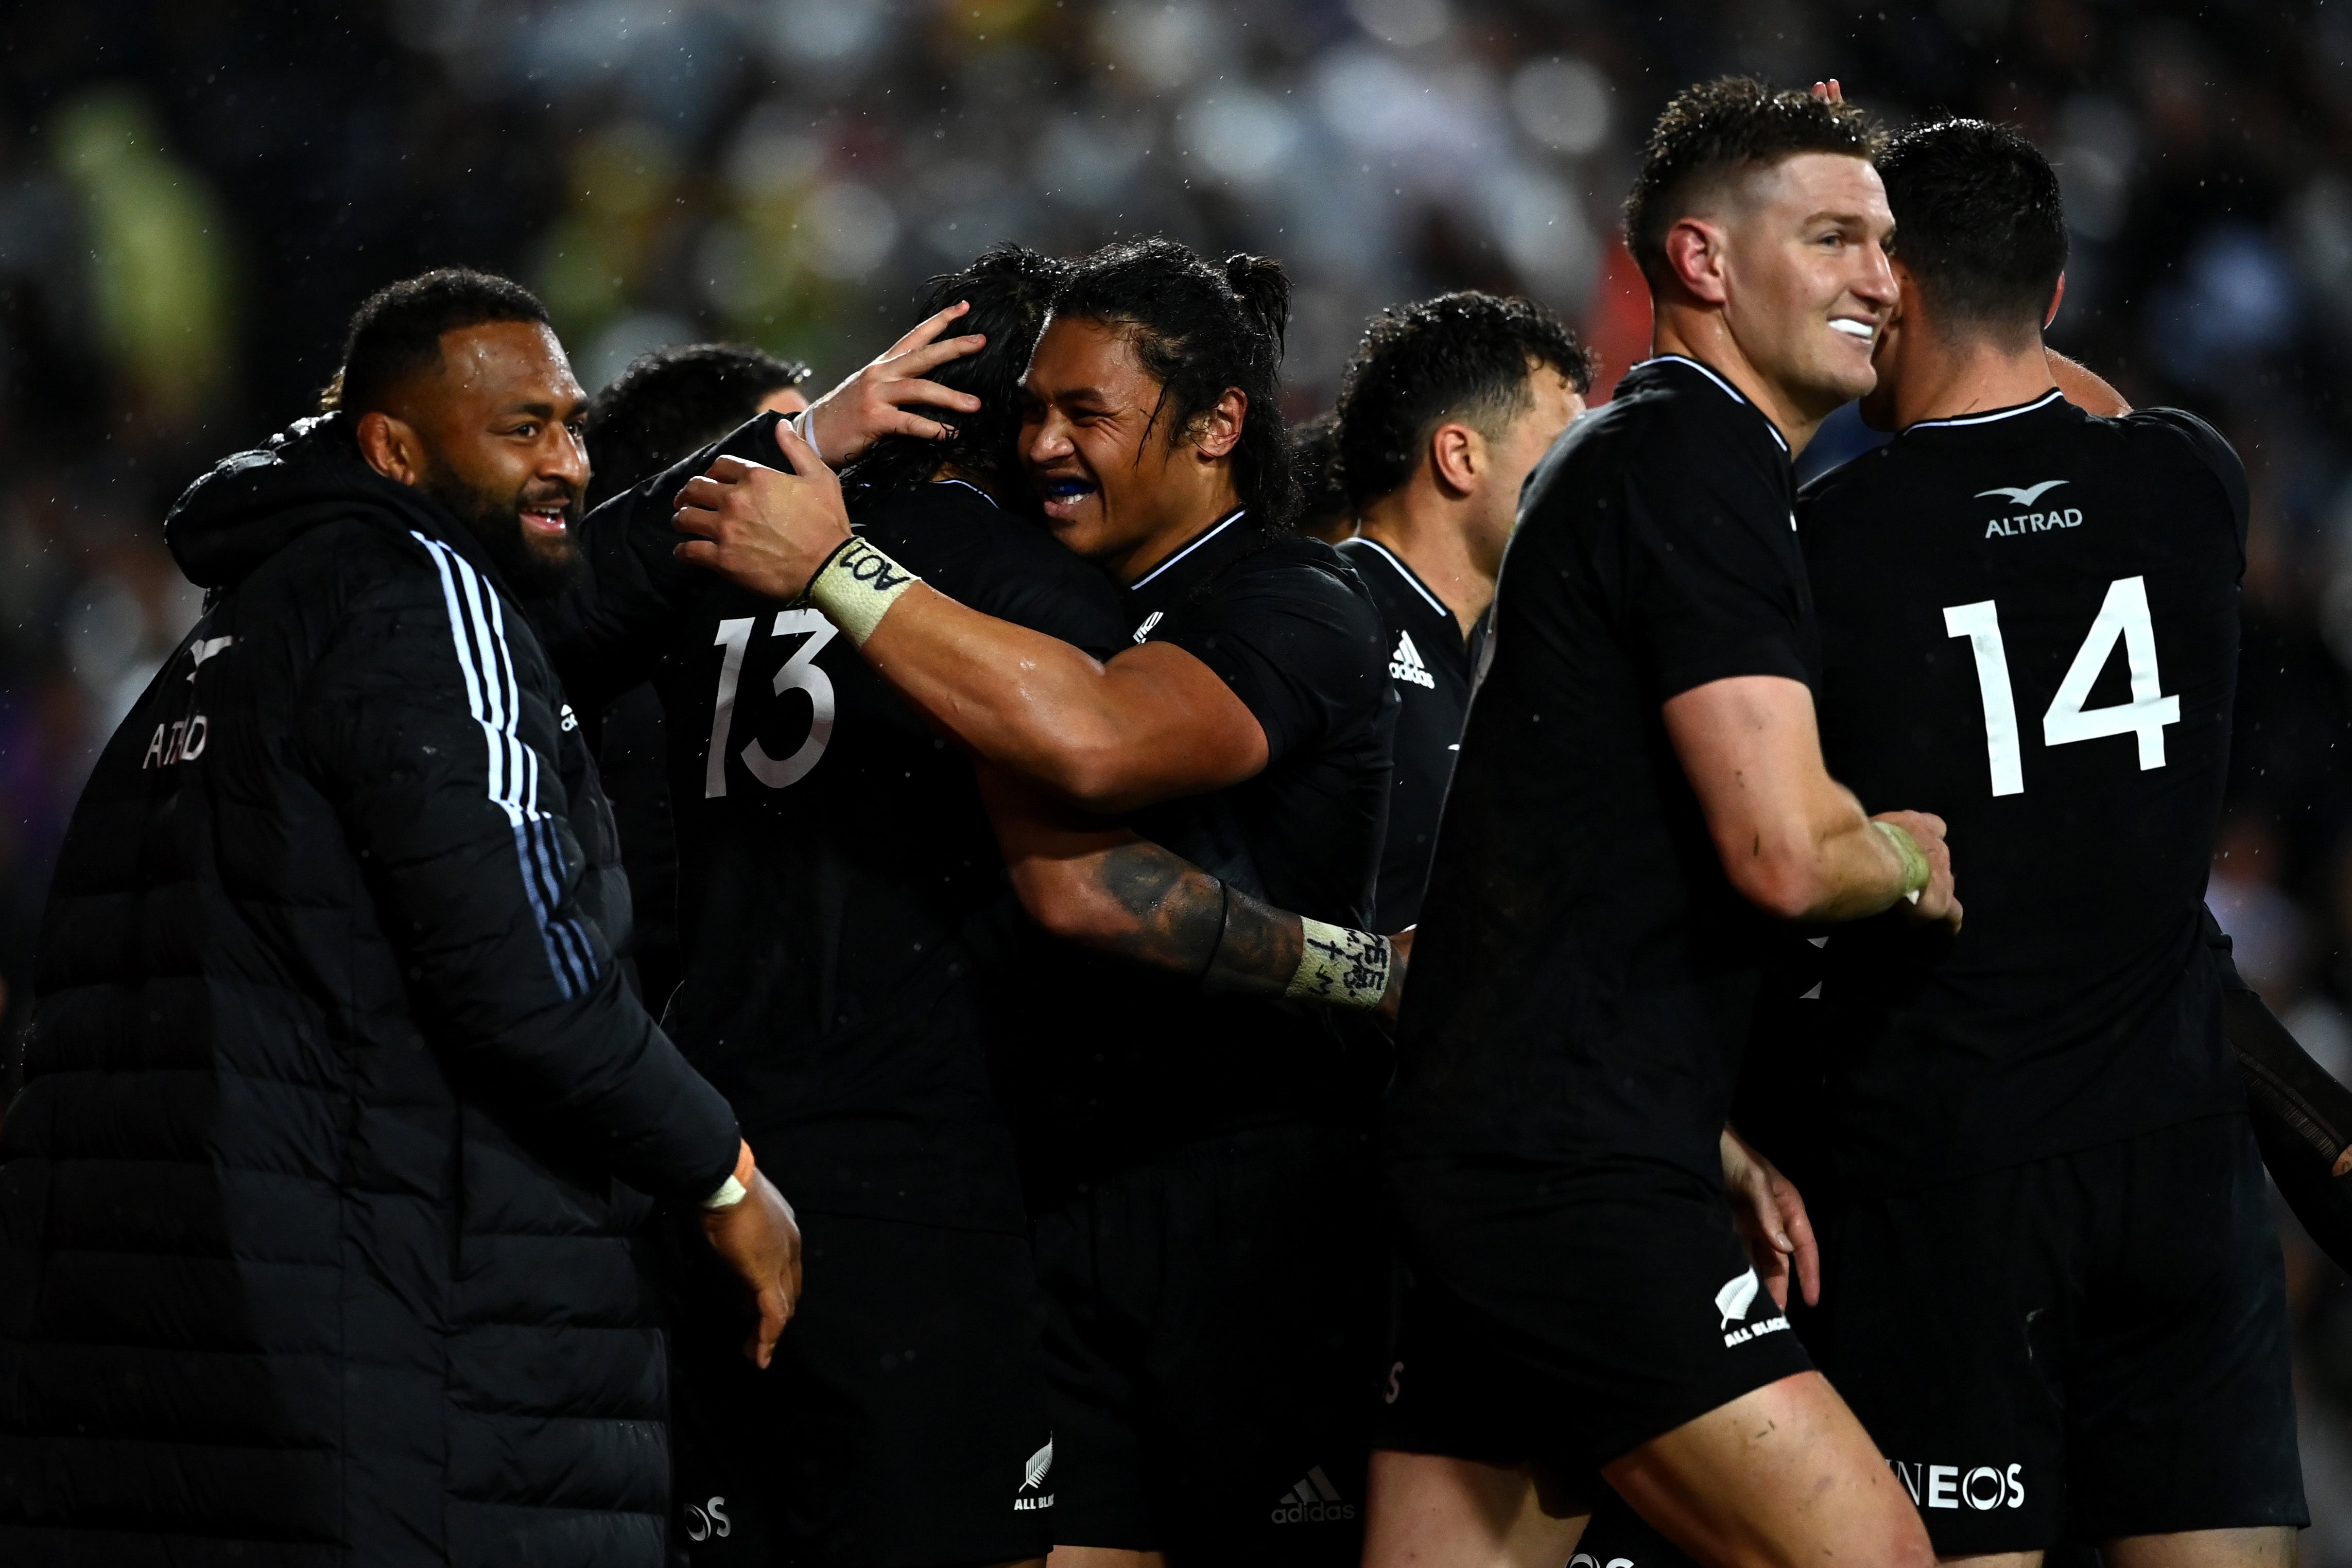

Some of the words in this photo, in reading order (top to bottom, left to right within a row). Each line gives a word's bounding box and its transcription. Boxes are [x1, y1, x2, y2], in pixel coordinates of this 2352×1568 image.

[1985, 508, 2083, 538] ALTRAD
[1389, 662, 1435, 689] adidas
[1943, 575, 2181, 797] 14
[705, 608, 839, 798] 13
[1723, 1327, 1753, 1349] ALL
[1885, 1459, 2025, 1511] NEOS
[1014, 1499, 1036, 1511] ALL
[1271, 1501, 1356, 1524] adidas
